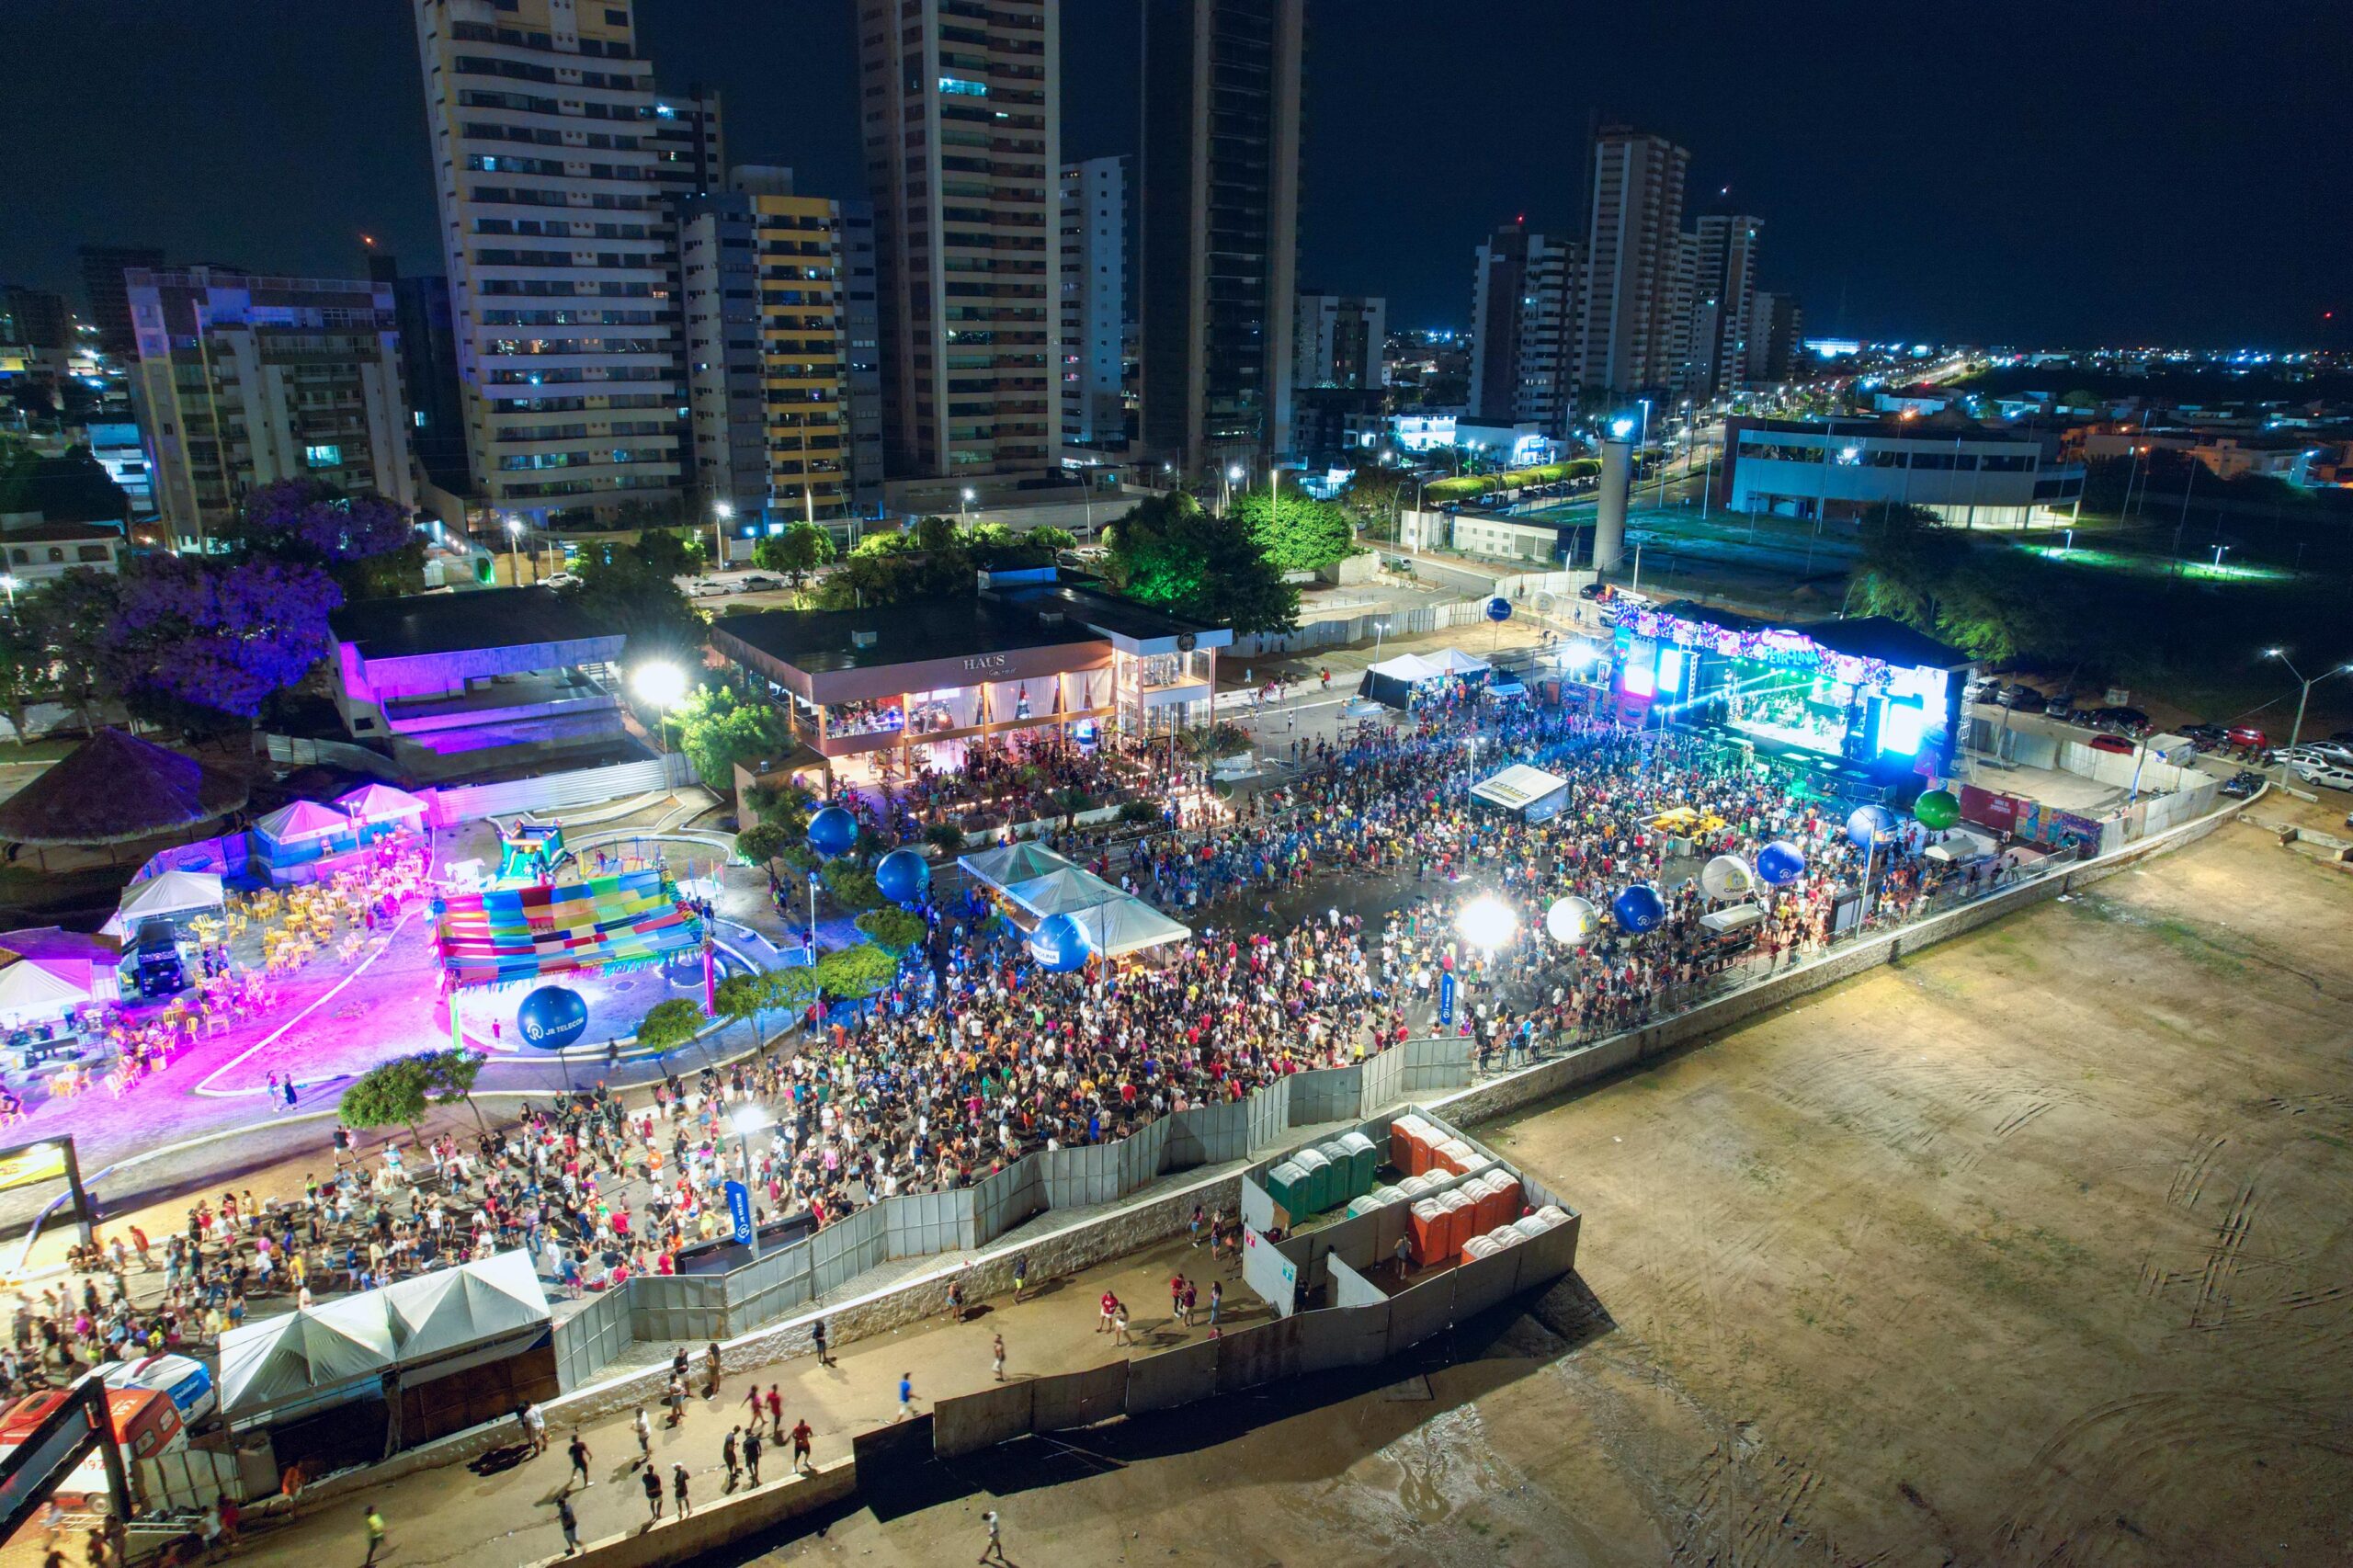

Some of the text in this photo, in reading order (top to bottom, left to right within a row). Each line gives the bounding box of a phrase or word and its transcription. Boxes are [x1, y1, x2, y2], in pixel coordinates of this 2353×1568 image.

[963, 654, 1006, 670] HAUS
[1763, 645, 1820, 665] PETROLINA
[545, 1017, 585, 1036] JR TELECOM
